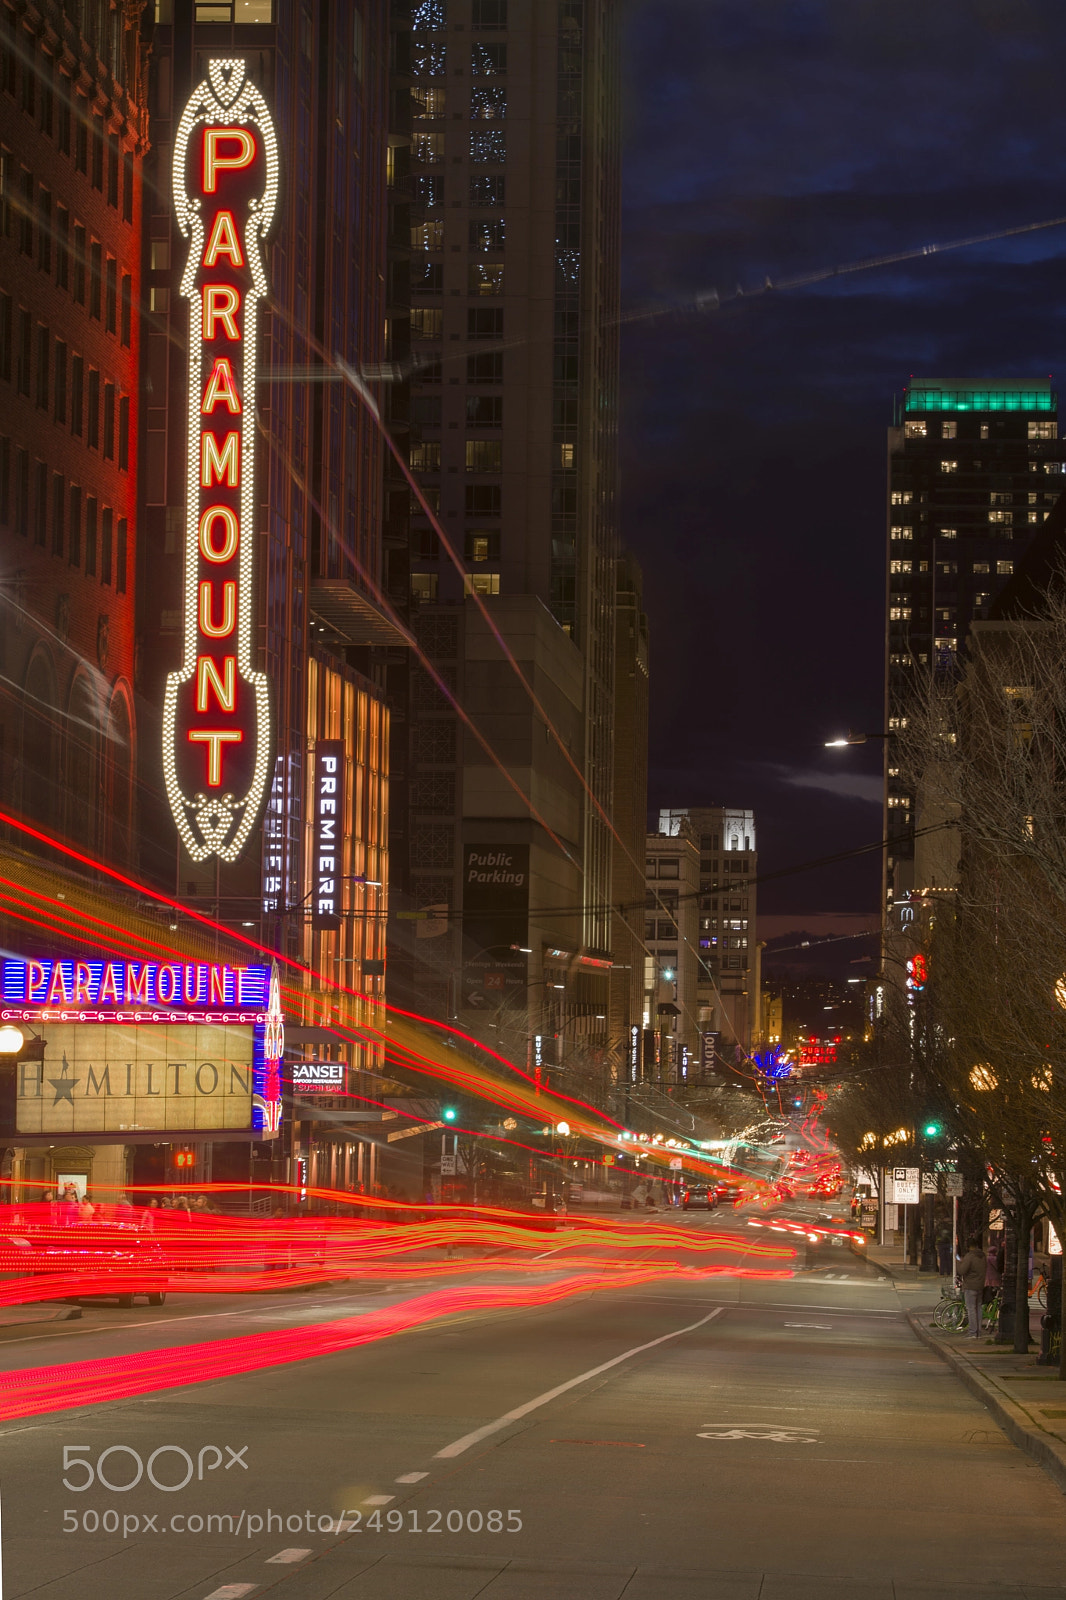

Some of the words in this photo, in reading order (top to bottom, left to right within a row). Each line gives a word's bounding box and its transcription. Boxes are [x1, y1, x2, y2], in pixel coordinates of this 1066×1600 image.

[188, 126, 256, 787] PARAMOUNT
[318, 756, 337, 914] PREMIERE
[468, 852, 513, 866] Public
[468, 870, 525, 886] Parking
[28, 960, 249, 1004] PARAMOUNT
[487, 976, 501, 986] 24
[704, 1036, 715, 1059] OLD
[801, 1047, 836, 1055] PUBLIC
[293, 1065, 343, 1078] SANSEI
